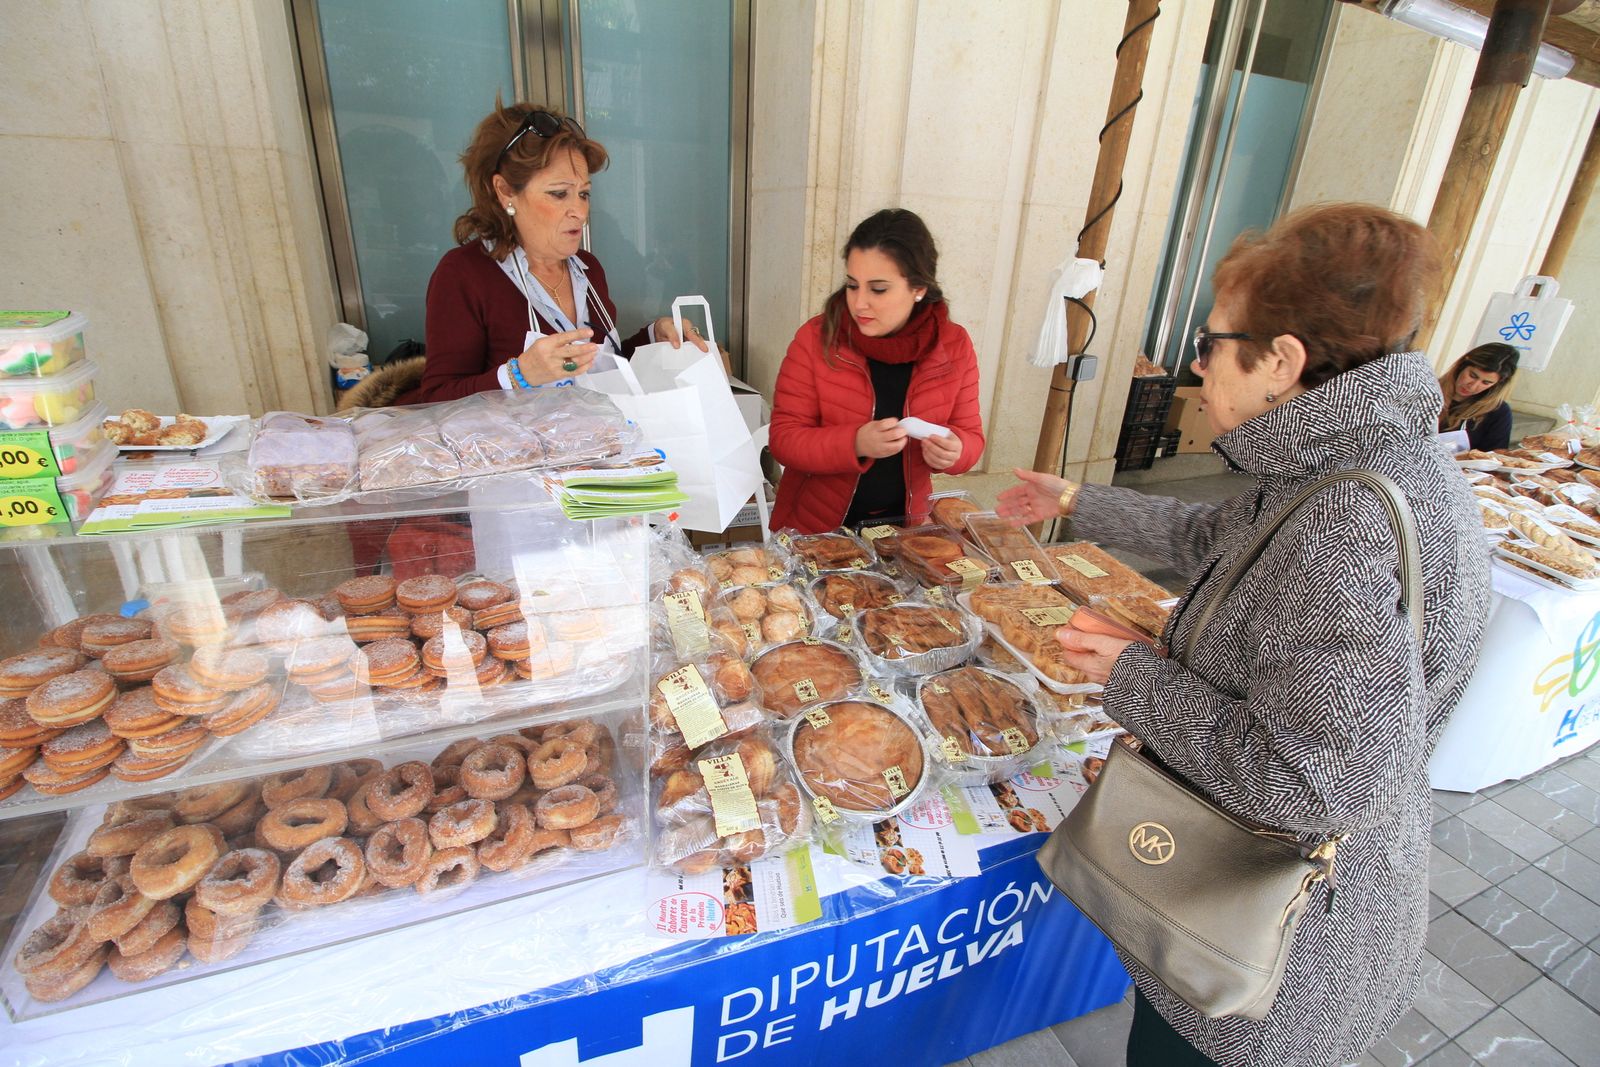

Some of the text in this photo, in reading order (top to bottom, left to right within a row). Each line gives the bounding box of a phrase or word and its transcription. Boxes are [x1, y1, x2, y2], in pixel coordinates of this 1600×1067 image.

[665, 668, 688, 681] VILLA
[707, 756, 732, 765] VILLA
[1133, 827, 1172, 860] MK
[659, 899, 667, 922] Muestra
[667, 906, 677, 934] Sabores
[678, 899, 688, 933] Cuaresma
[697, 901, 705, 928] Provincia
[720, 881, 1054, 1026] DIPUTACIÓN
[716, 1014, 796, 1063] DE
[819, 920, 1024, 1031] HUELVA
